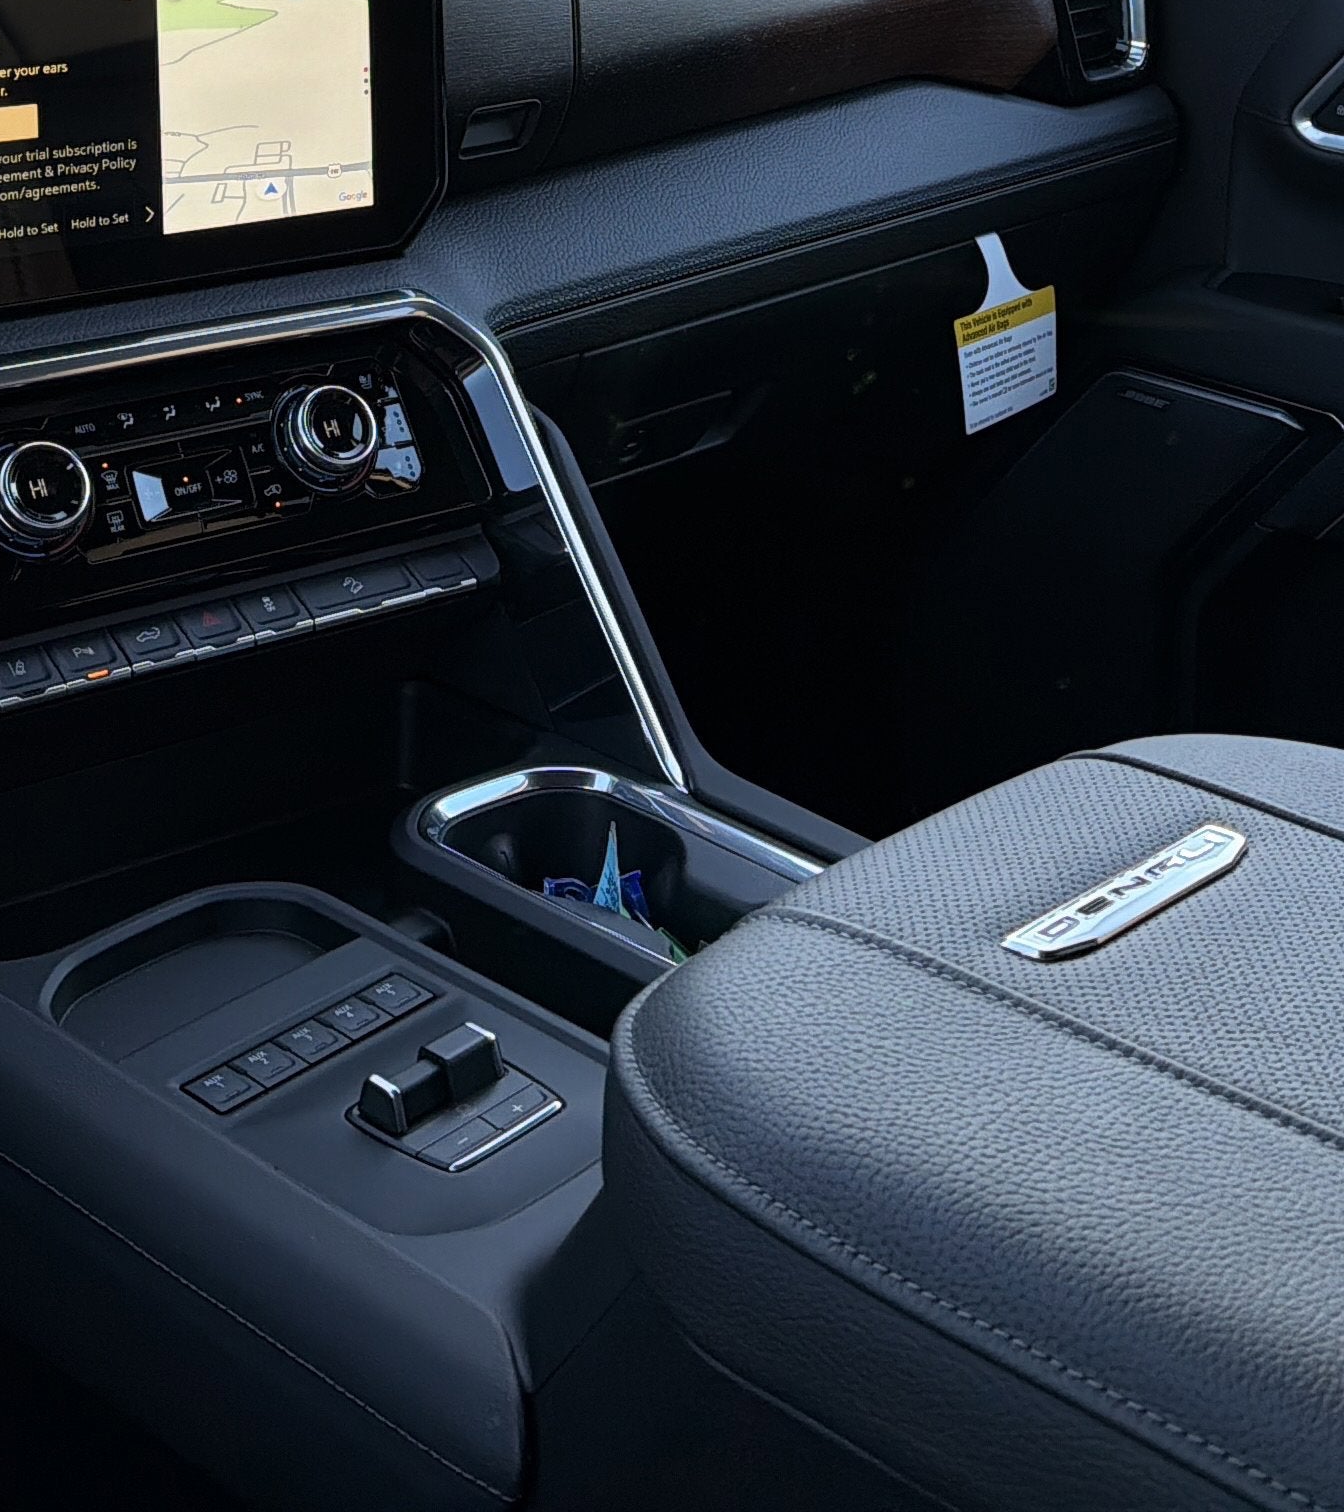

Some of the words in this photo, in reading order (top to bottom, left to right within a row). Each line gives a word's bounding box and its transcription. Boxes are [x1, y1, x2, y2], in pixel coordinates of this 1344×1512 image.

[13, 66, 40, 80] your
[42, 63, 69, 75] ears
[25, 147, 50, 162] trial
[52, 139, 125, 159] subscription
[127, 138, 138, 151] is
[44, 166, 55, 178] &
[57, 160, 99, 176] Privacy
[102, 156, 137, 172] Policy
[338, 190, 368, 203] Google
[70, 216, 96, 230] Hold
[98, 215, 110, 227] to
[112, 212, 130, 225] Set
[26, 225, 38, 237] to
[40, 222, 60, 235] Set
[971, 313, 992, 327] Vehicle
[997, 303, 1021, 318] Equipped
[962, 325, 988, 343] Advanced
[244, 389, 265, 402] SYNC
[74, 422, 96, 435] AUTO
[322, 417, 342, 439] HI
[251, 442, 265, 454] A/C
[28, 477, 49, 500] HI
[174, 483, 203, 497] ON/OFF
[1037, 830, 1227, 939] DENALI
[375, 982, 394, 996] AUX
[334, 1003, 353, 1017] AUX
[291, 1026, 311, 1040] AUX
[247, 1049, 268, 1064] AUX
[203, 1074, 223, 1087] AUX
